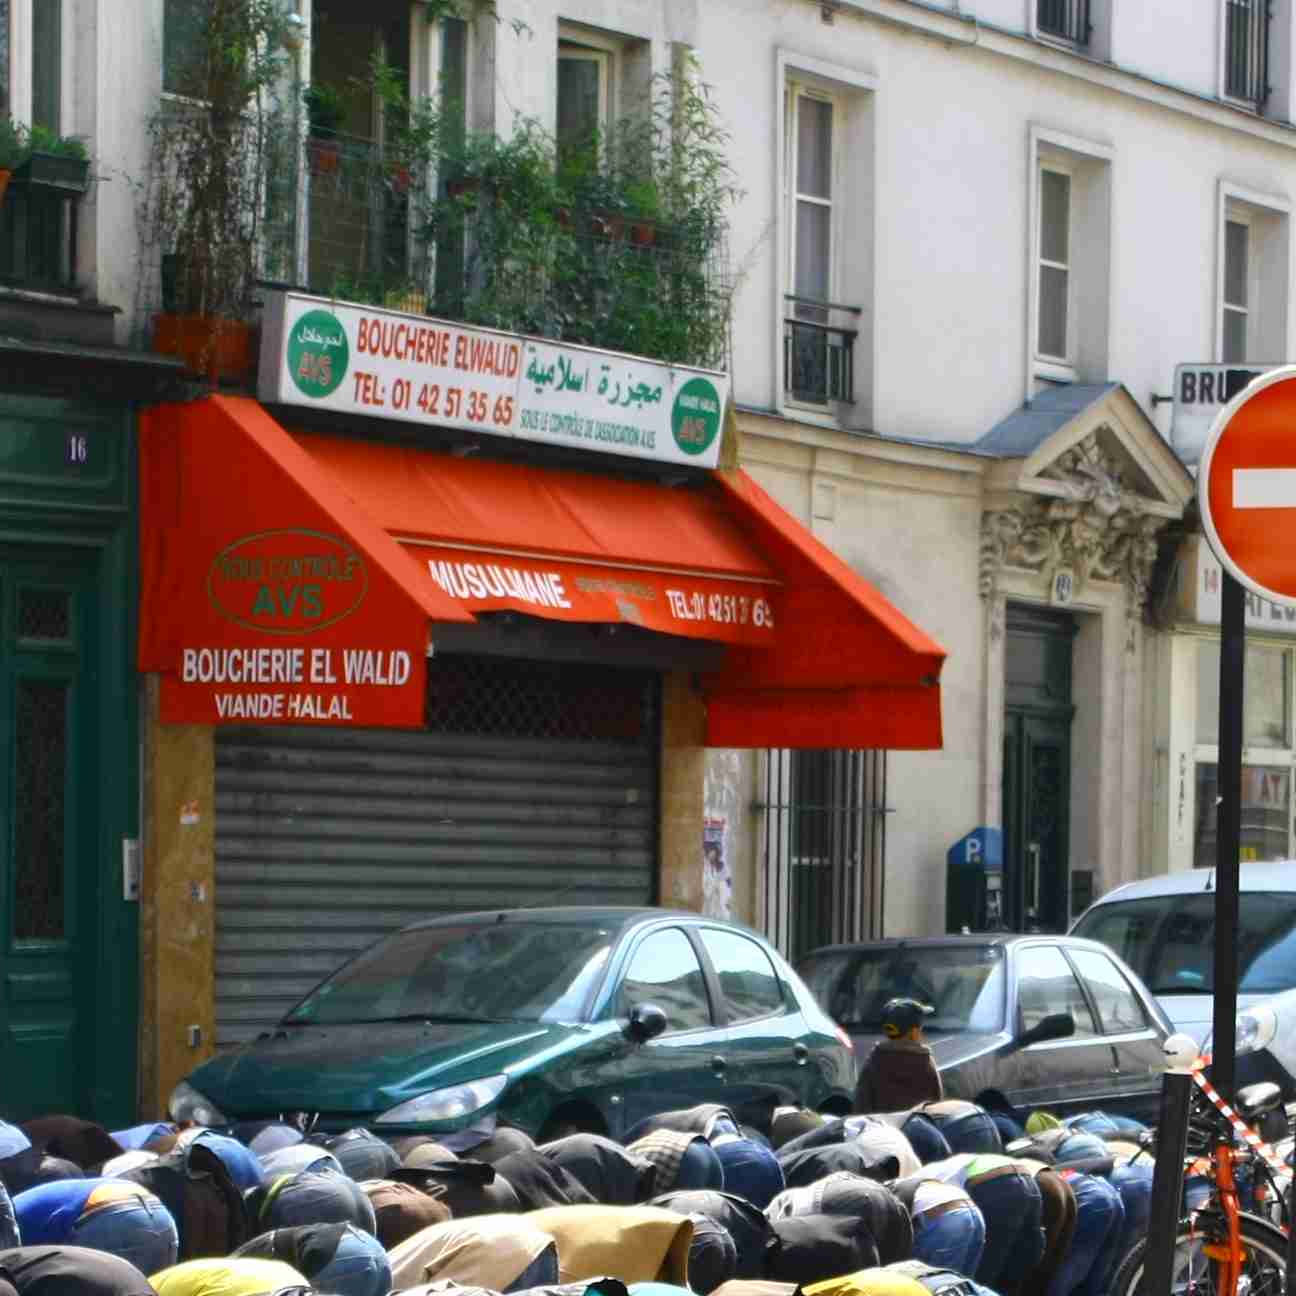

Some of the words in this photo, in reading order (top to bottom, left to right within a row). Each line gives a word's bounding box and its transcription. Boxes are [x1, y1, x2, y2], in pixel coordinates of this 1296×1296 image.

[356, 318, 450, 368] BOUCHERIE
[391, 379, 412, 410] 01
[417, 383, 439, 416] 42
[444, 388, 462, 418] 51
[466, 391, 488, 422] 35
[492, 396, 513, 426] 65
[68, 435, 88, 464] 16
[251, 583, 325, 618] AVS
[427, 559, 573, 609] MUSULMANE
[183, 647, 305, 684] BOUCHERIE
[310, 648, 337, 684] EL
[342, 649, 412, 686] WALID
[214, 692, 285, 719] VIANDE
[286, 693, 353, 720] HALAL
